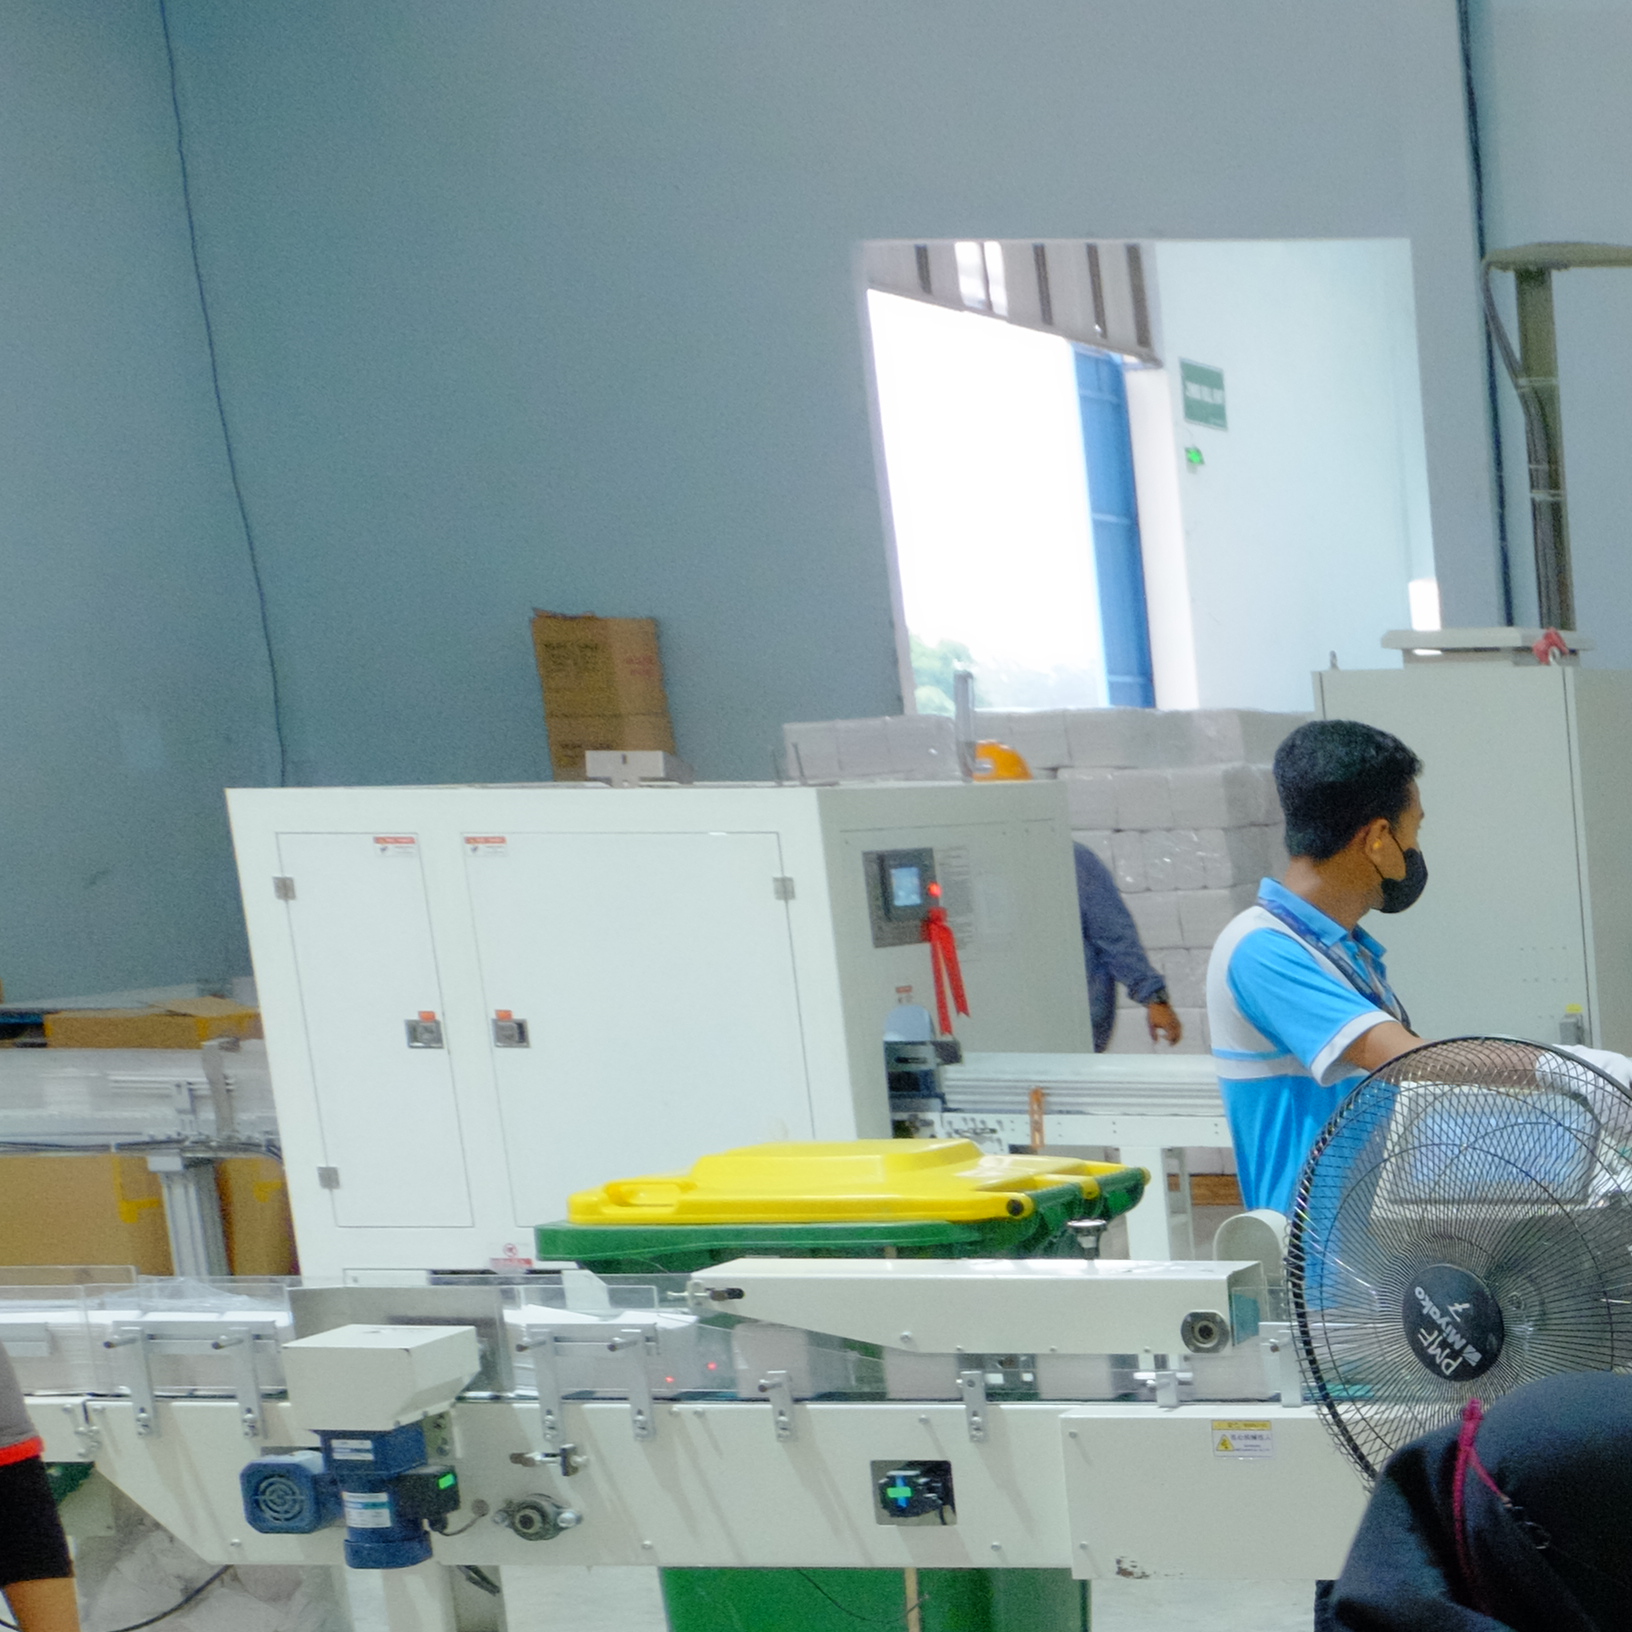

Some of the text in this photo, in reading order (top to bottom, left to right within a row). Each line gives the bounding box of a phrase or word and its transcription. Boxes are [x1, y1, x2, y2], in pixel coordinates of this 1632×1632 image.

[1414, 1286, 1468, 1351] Miyako
[1447, 1302, 1471, 1322] 7
[1418, 1328, 1463, 1375] PMF
